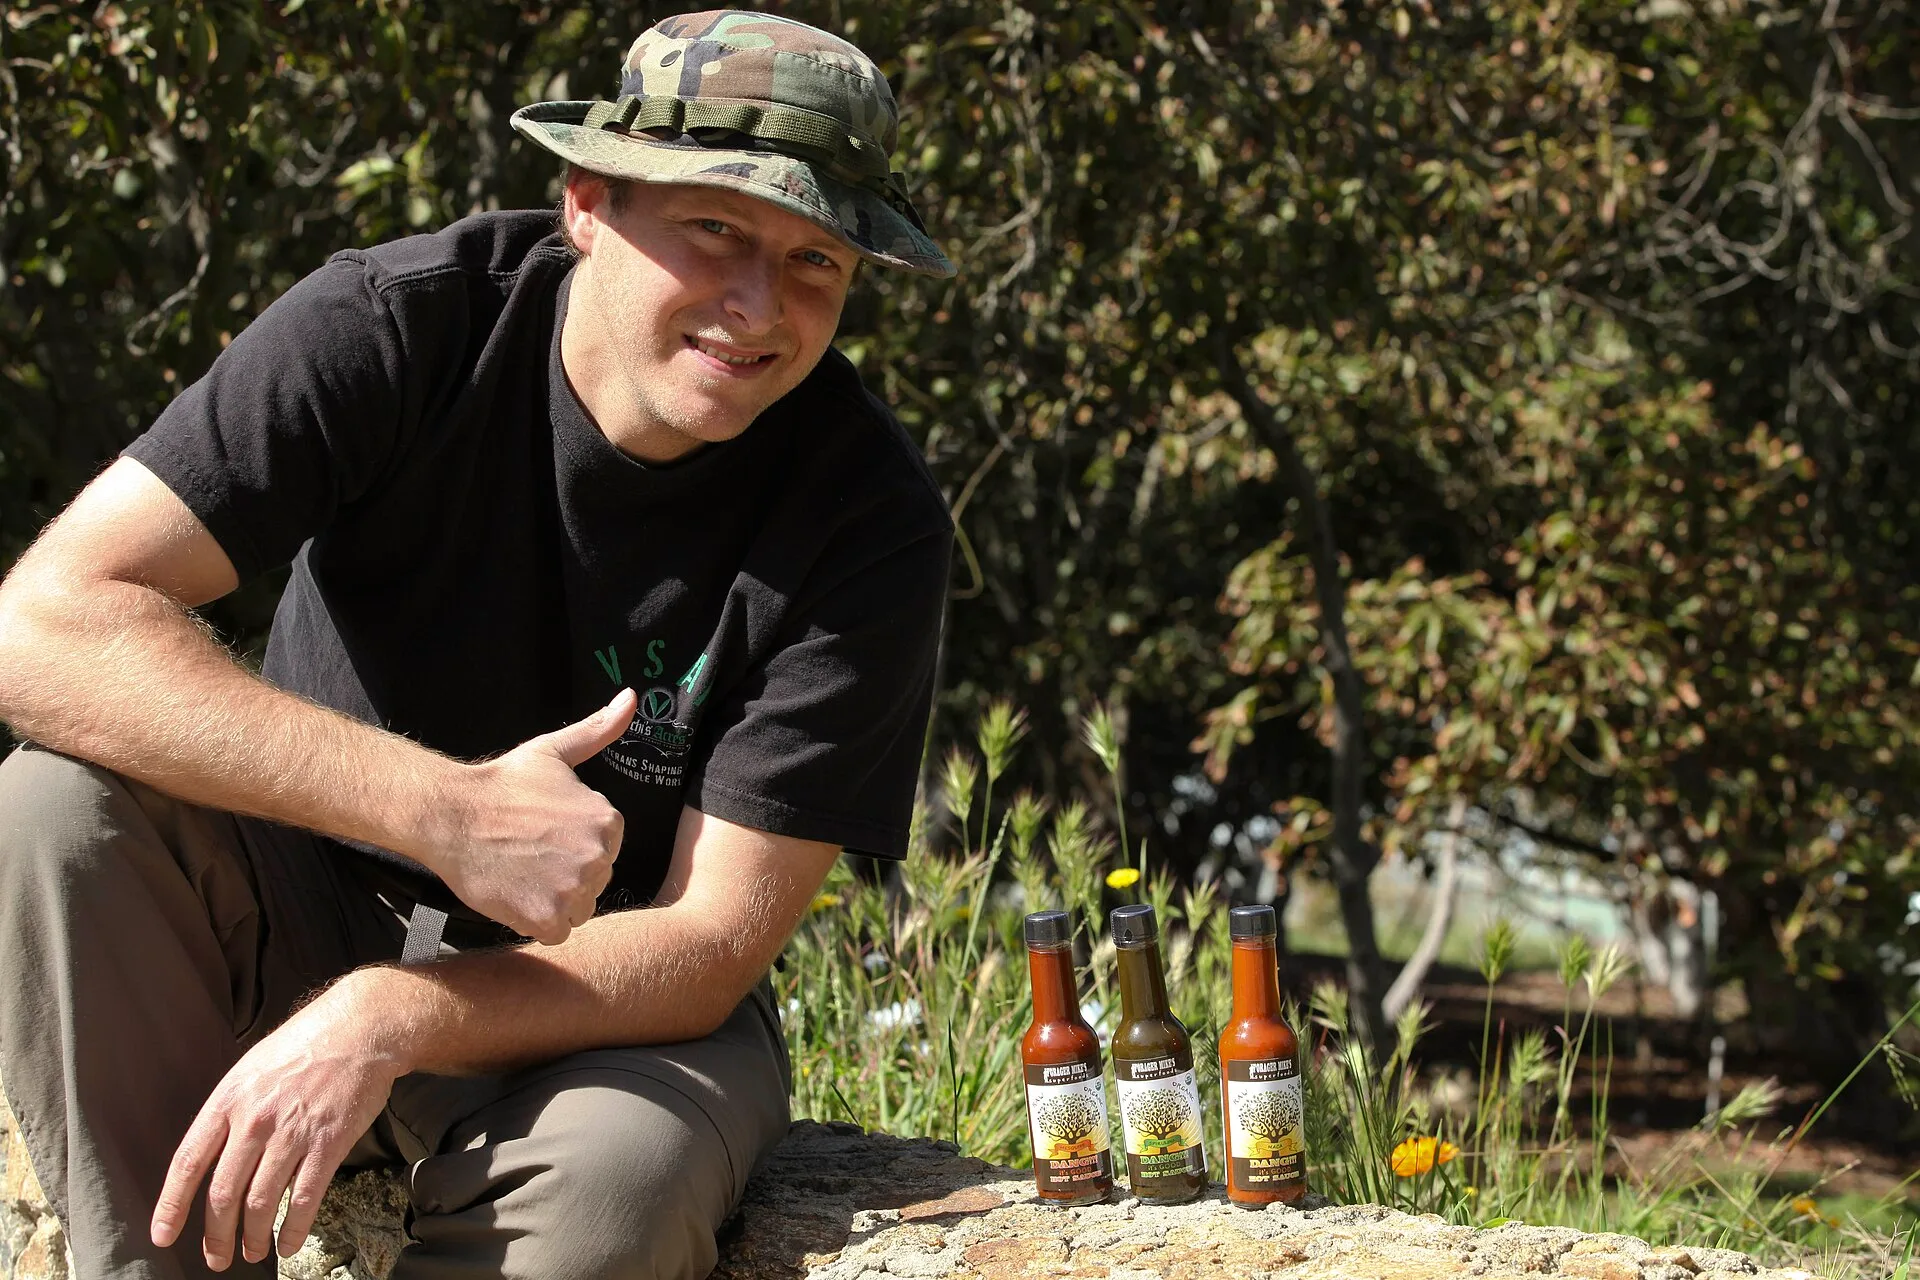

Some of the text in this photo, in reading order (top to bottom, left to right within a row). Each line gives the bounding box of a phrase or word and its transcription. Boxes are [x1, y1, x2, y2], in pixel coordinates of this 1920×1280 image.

[629, 719, 653, 736] chi's
[653, 725, 687, 744] Acres
[605, 746, 639, 768] TERANS
